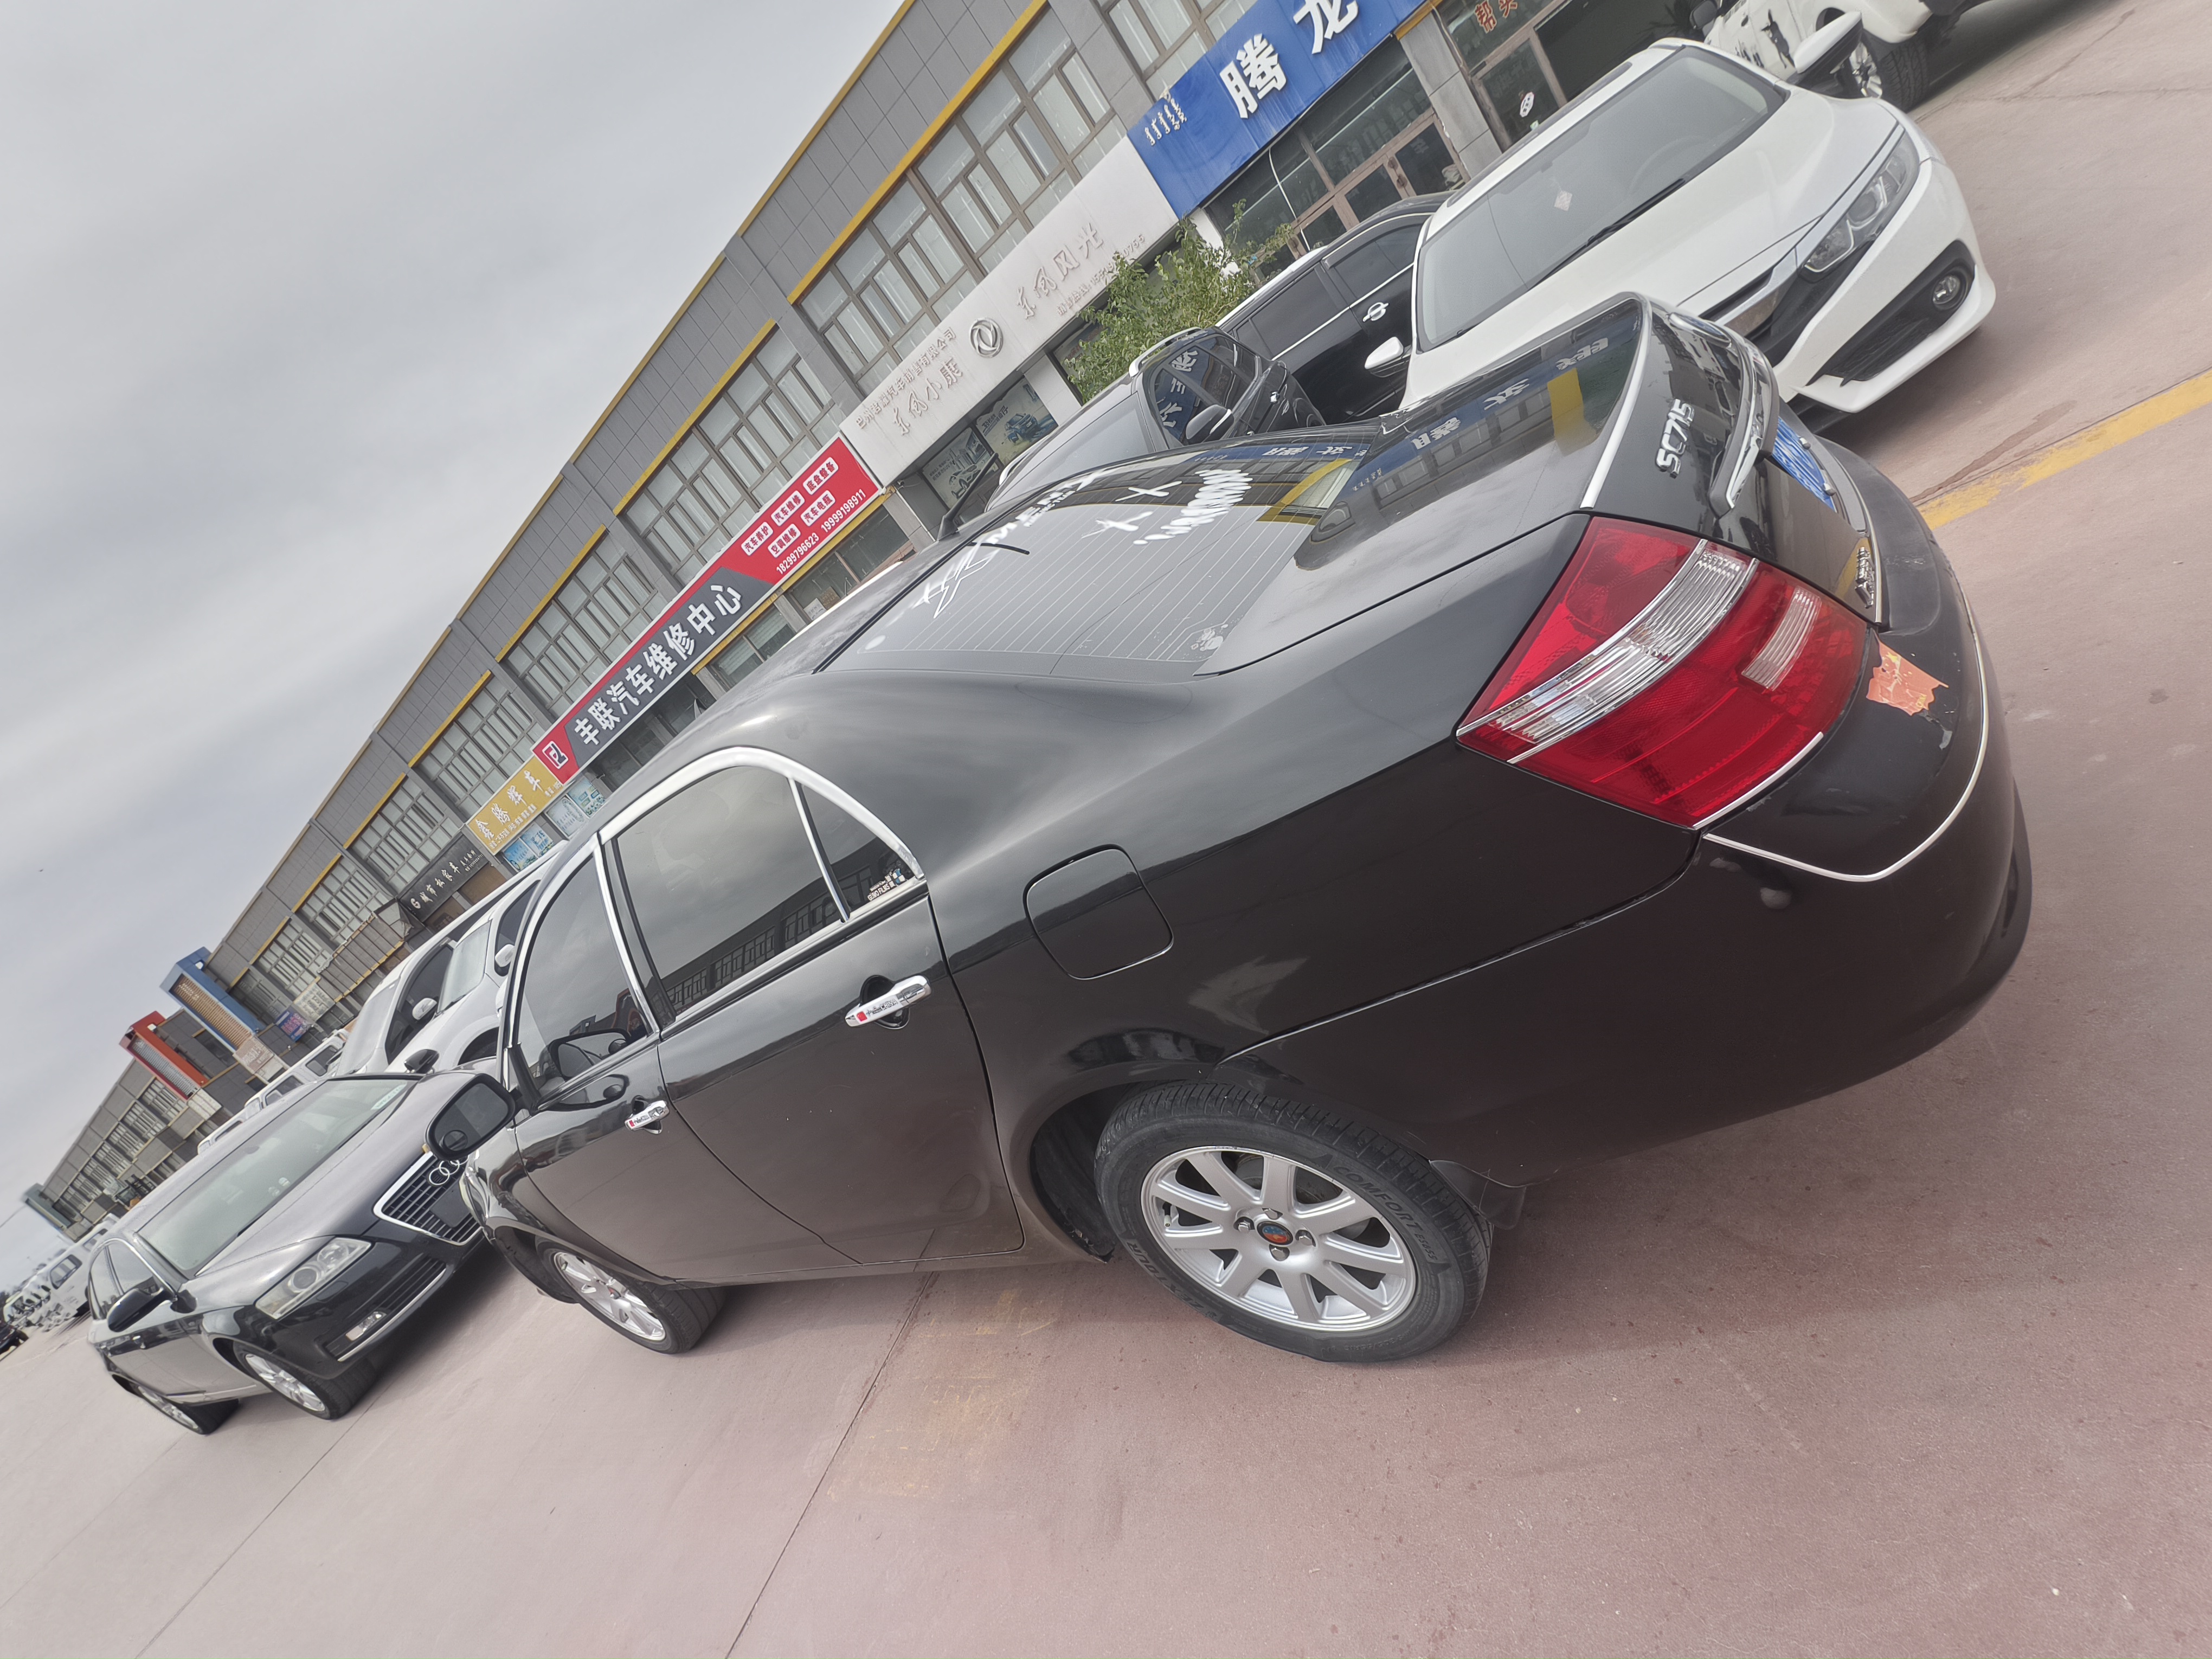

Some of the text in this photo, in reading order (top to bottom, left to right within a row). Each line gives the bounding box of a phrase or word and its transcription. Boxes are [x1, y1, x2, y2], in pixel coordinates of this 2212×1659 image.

[1655, 399, 1695, 479] SC715
[743, 524, 770, 554] 汽车养护
[773, 493, 803, 524] 汽车维修
[775, 489, 866, 575] 18299796623 19999198911
[574, 584, 743, 746] 丰联汽车维修中心
[1333, 1166, 1423, 1231] COMFORT
